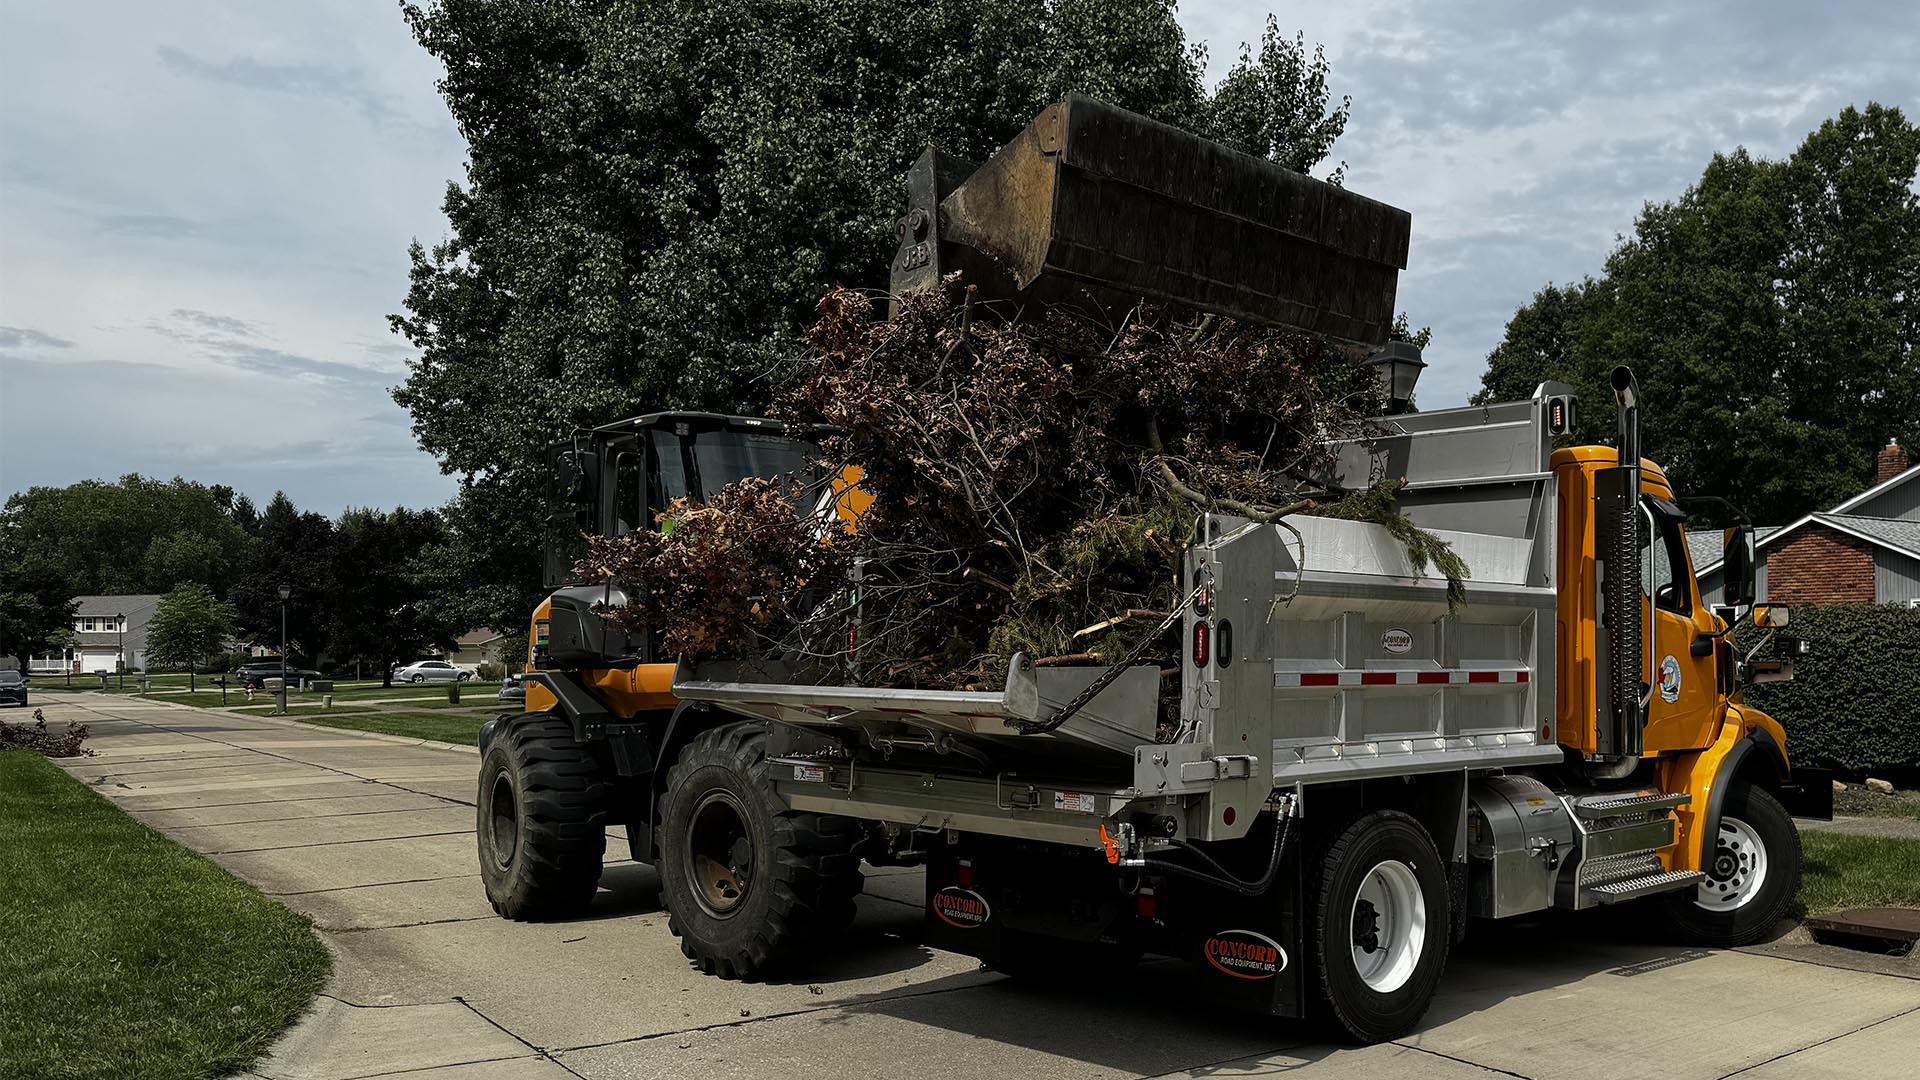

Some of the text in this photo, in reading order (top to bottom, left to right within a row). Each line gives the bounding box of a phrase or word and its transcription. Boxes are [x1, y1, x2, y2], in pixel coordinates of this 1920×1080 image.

[937, 893, 983, 915] CONCORD
[1210, 938, 1277, 963] CONCORD
[1219, 956, 1234, 965] ROAD
